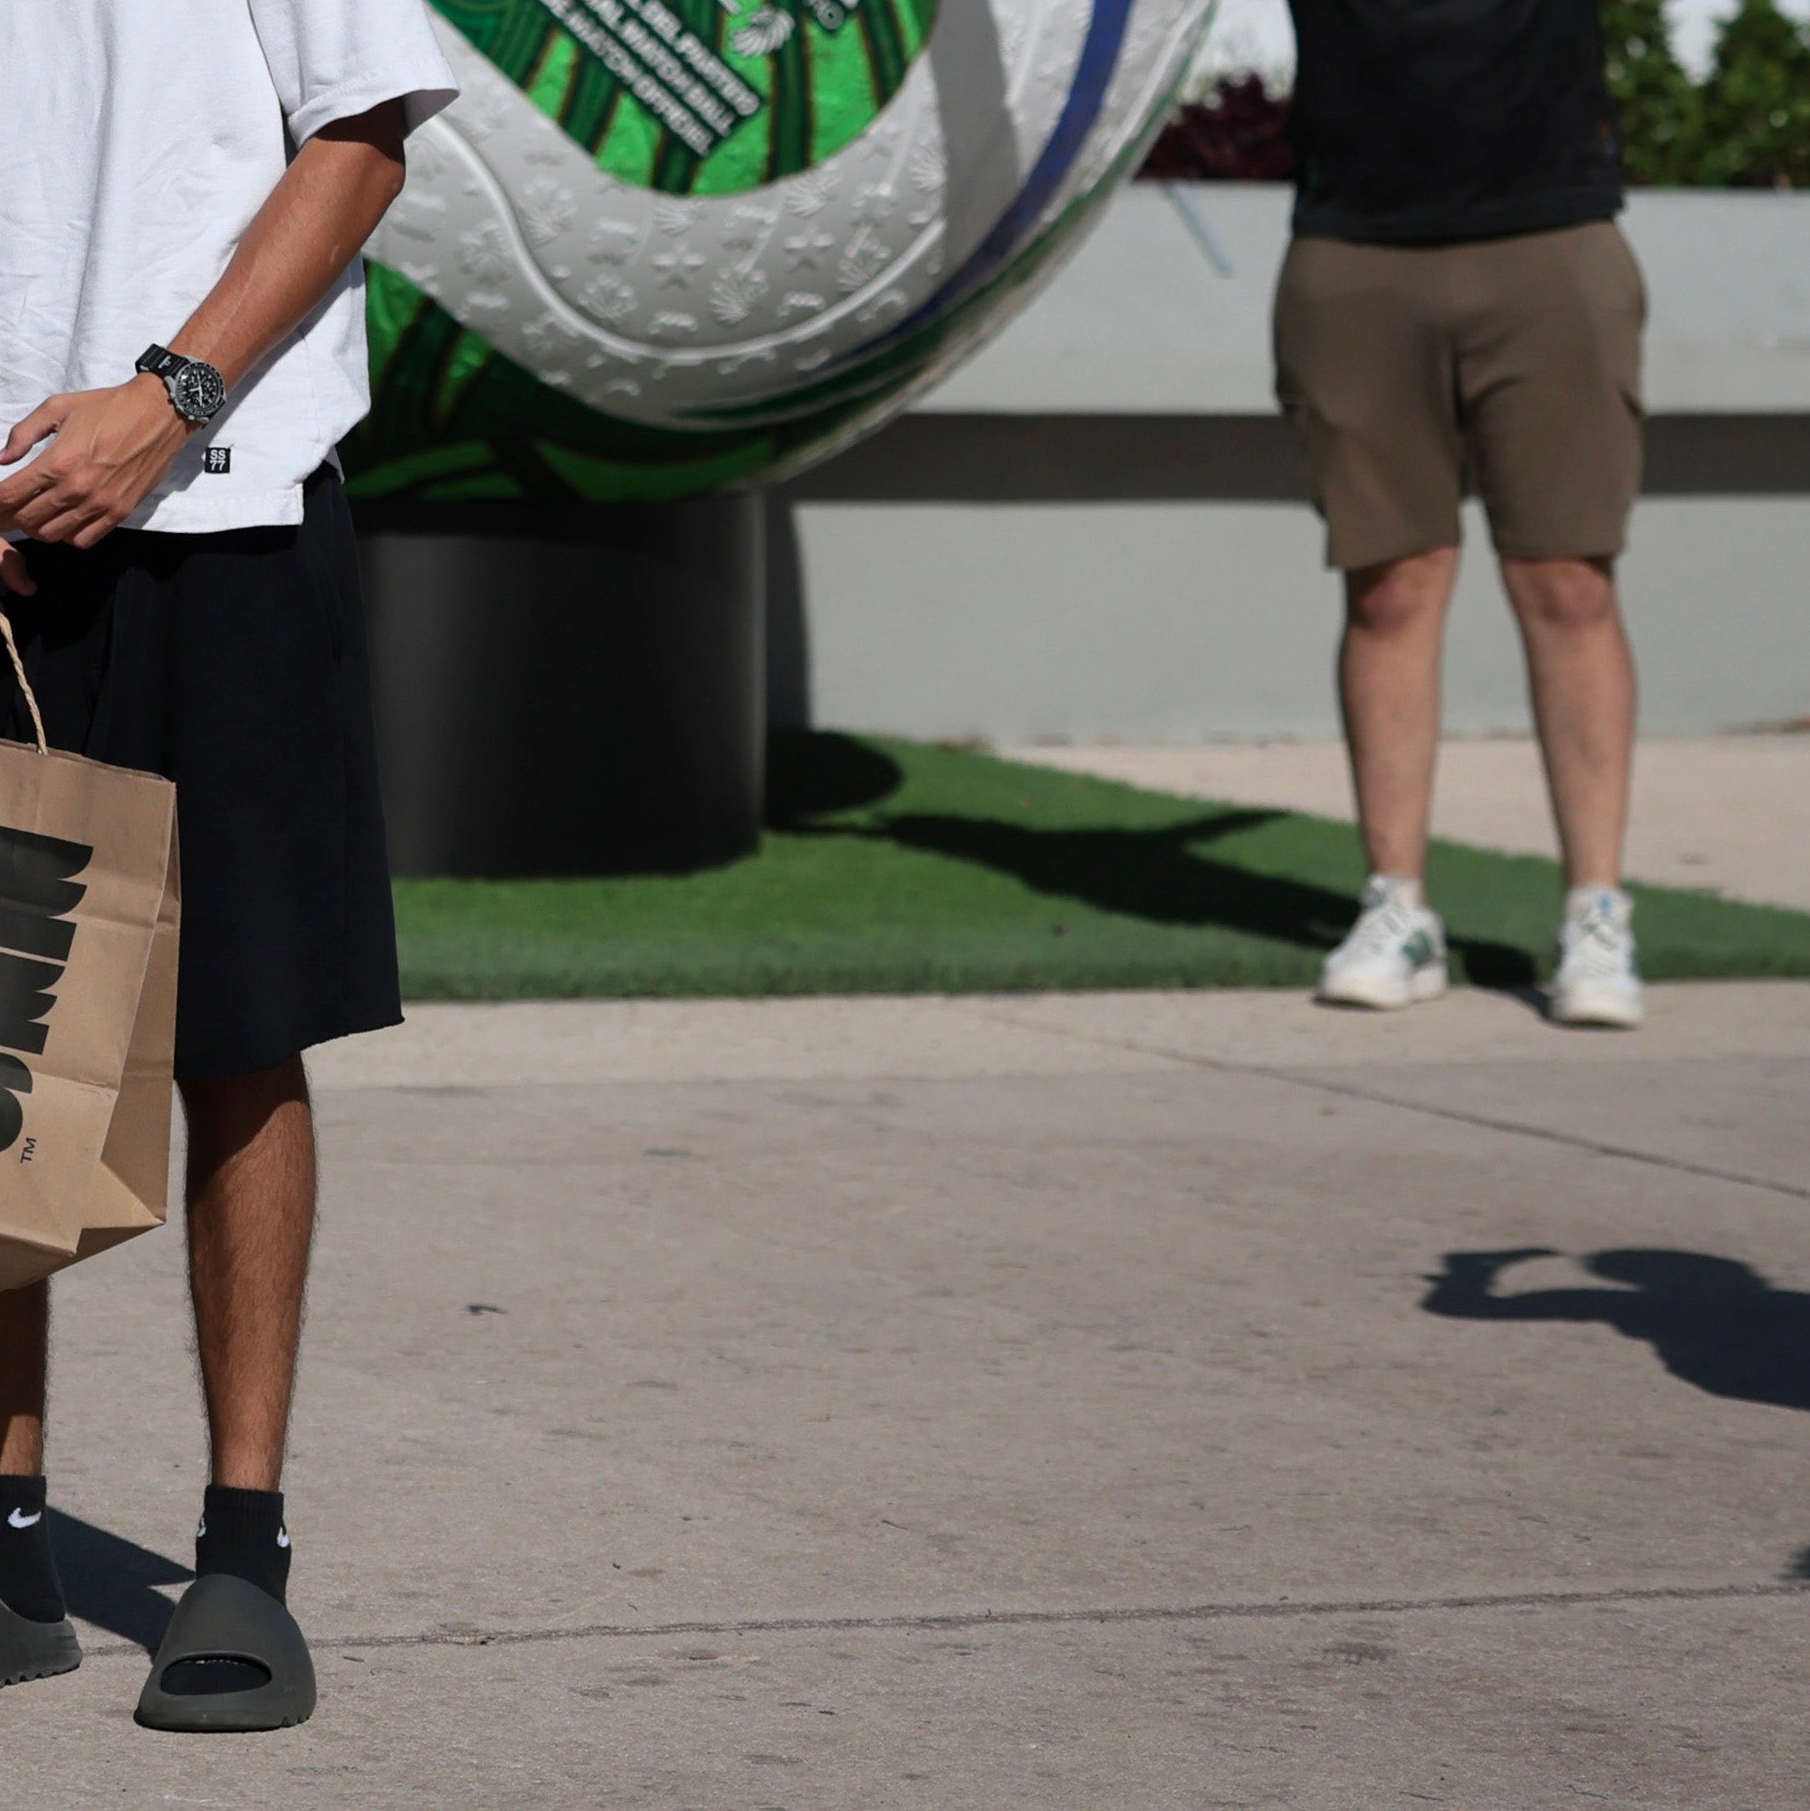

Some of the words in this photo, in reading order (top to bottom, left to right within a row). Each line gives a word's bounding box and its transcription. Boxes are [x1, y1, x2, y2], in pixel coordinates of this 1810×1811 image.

[209, 449, 226, 460] SS
[209, 460, 226, 471] 77
[20, 1137, 37, 1163] TM
